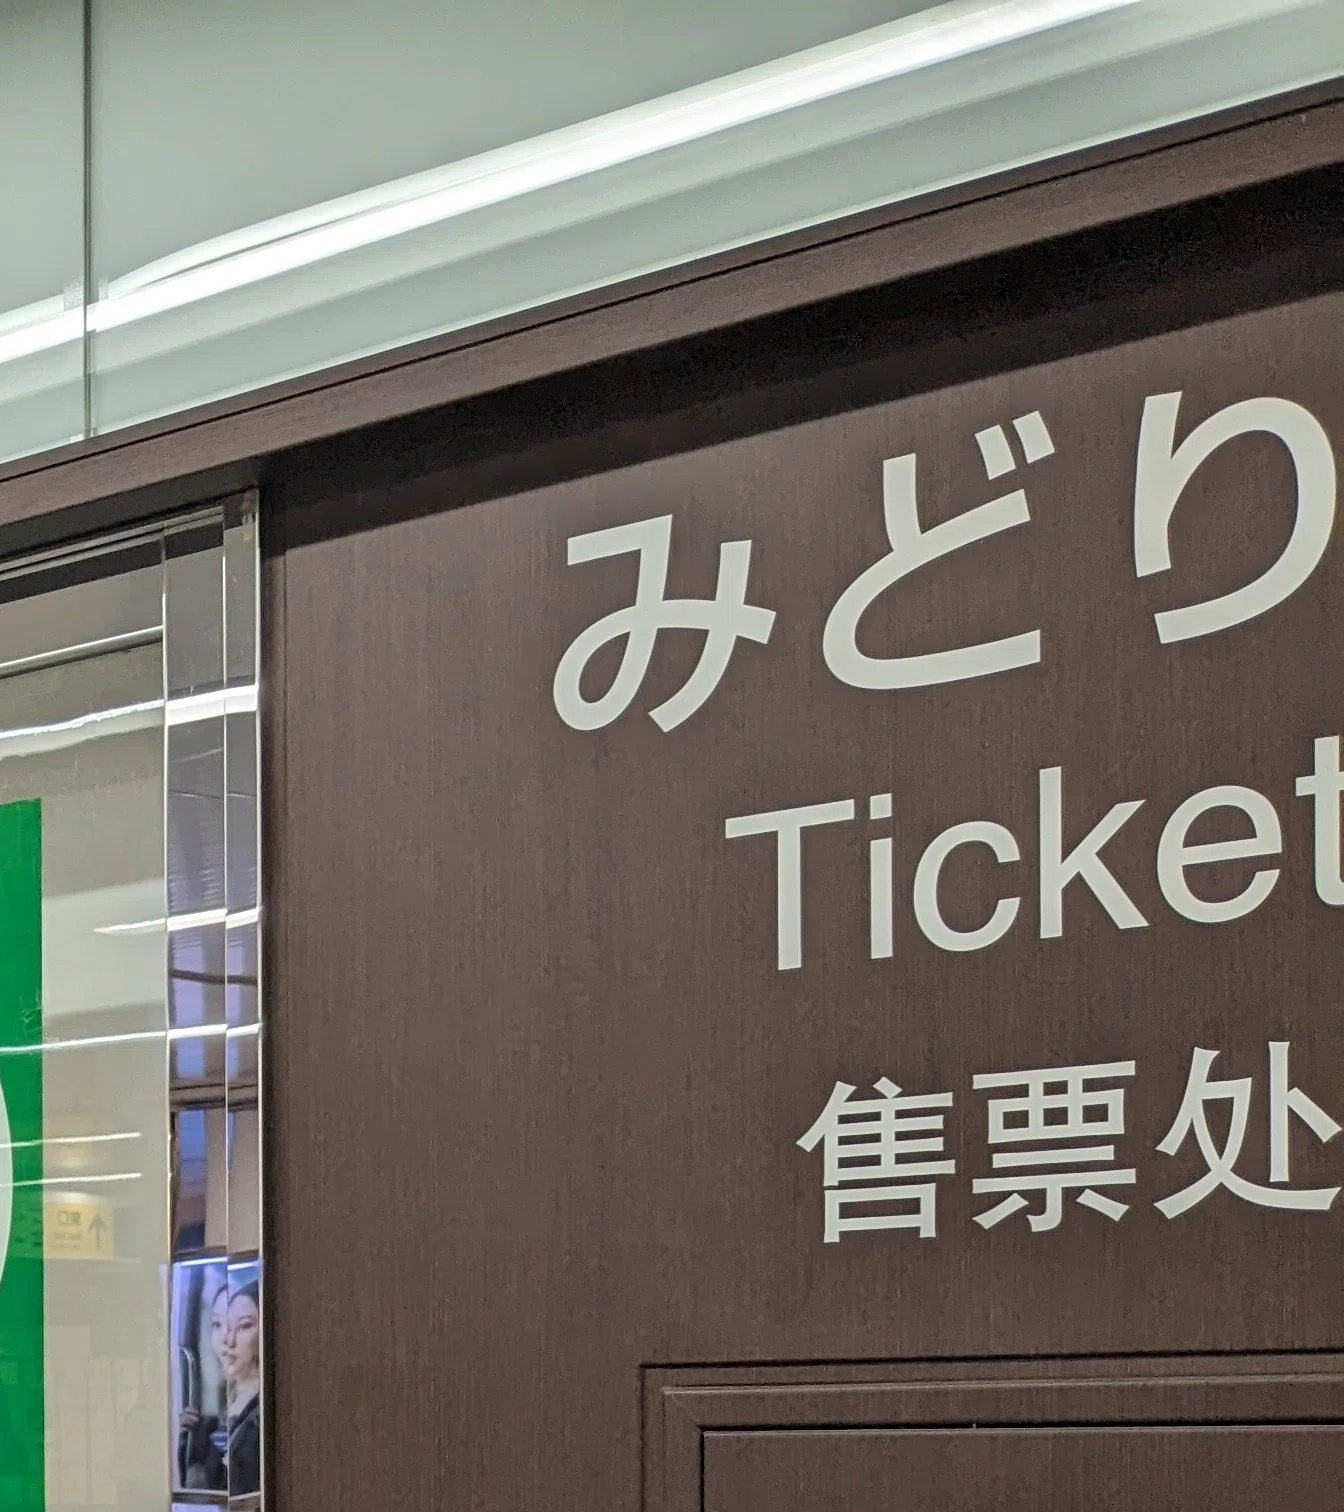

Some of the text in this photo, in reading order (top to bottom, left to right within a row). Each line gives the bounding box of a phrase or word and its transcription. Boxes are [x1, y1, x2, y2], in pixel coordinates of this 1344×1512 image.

[552, 391, 1338, 733] みどり
[725, 735, 1344, 971] Ticket
[796, 1041, 1343, 1244] 售票处
